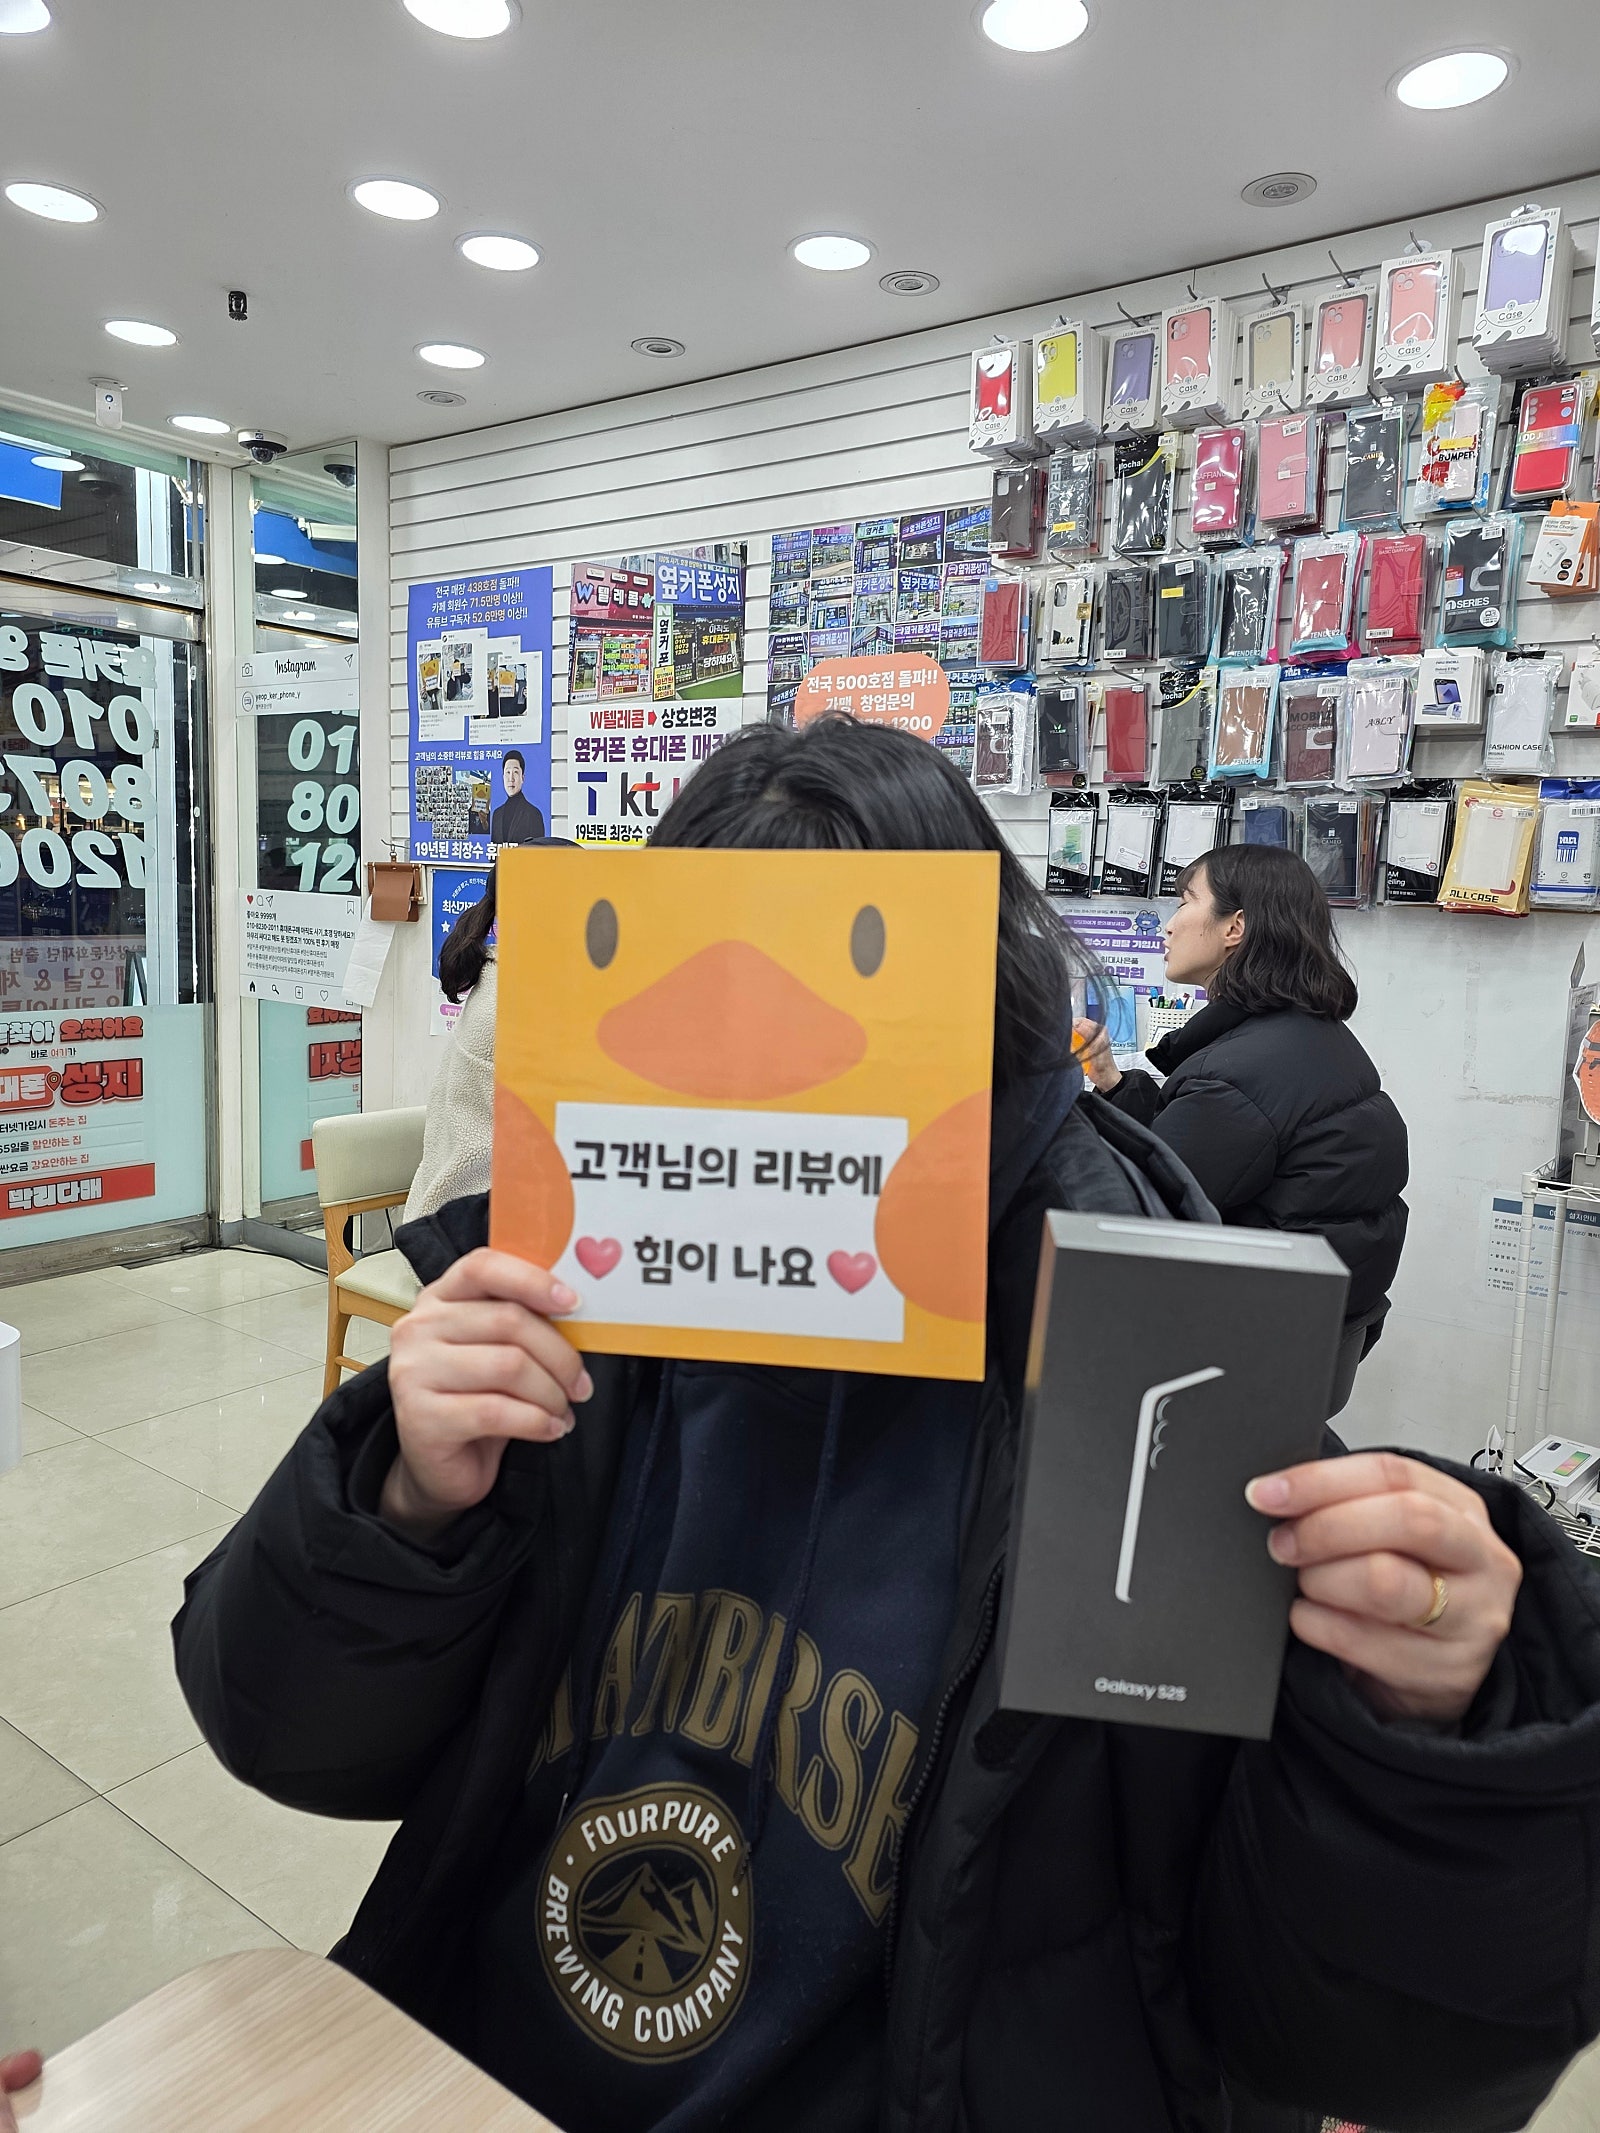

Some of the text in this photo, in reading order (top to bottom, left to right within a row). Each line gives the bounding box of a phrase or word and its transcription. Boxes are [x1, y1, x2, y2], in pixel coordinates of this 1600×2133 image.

[1498, 310, 1523, 321] Case
[1398, 345, 1421, 355] Case
[1327, 373, 1348, 383] Case
[1179, 384, 1198, 394] Case
[1261, 388, 1281, 398] Case
[1050, 403, 1066, 412] Case
[1120, 406, 1138, 414] Case
[985, 422, 1001, 430] Case
[436, 576, 520, 599] 전국 매장 438호점 돌파!!
[658, 565, 741, 603] 옆커폰성지
[856, 576, 893, 593] 옆커폰성지
[900, 576, 939, 590] 옆커폰성지
[432, 592, 523, 613] 카페 회원수 71.5만명 이상!!
[1457, 597, 1490, 608] SERIES
[426, 607, 528, 628] 유튜브 구독자 52.6만명 이상!!
[274, 659, 317, 679] Instagram
[807, 669, 938, 694] 전국 500호점 돌파!!
[860, 692, 915, 711] 창업문의
[590, 706, 717, 729] W텔레콤 상호변경
[1365, 716, 1396, 728] ABLY
[415, 751, 437, 761] 고객님의
[437, 751, 454, 760] 소중한
[455, 751, 472, 760] 리뷰로
[485, 750, 503, 759] 주세요
[574, 736, 626, 763] 옆커폰
[631, 735, 687, 763] 휴대폰
[577, 771, 661, 817] T kt
[575, 824, 643, 842] 19년된 최장수
[415, 841, 449, 859] 19년된
[451, 842, 484, 860] 최장수
[1388, 879, 1406, 887] elling
[1449, 889, 1500, 904] ALLCASE
[60, 1016, 143, 1042] 오셨어요
[30, 1047, 76, 1059] 바로 여기가
[61, 1057, 143, 1104] 성지
[48, 1116, 76, 1129] 돈주는
[78, 1115, 87, 1125] 집
[32, 1137, 70, 1150] 할인하는
[72, 1135, 82, 1145] 집
[31, 1156, 78, 1170] 강요안하는
[80, 1153, 89, 1163] 집
[571, 1141, 883, 1197] 고객님의 리뷰에
[8, 1177, 103, 1210] 박리다매
[635, 1236, 817, 1289] 힘이 나요
[1094, 1677, 1157, 1701] Galaxy
[580, 1800, 736, 1863] FOURPURE
[546, 1873, 745, 2044] BREWING COMPANY
